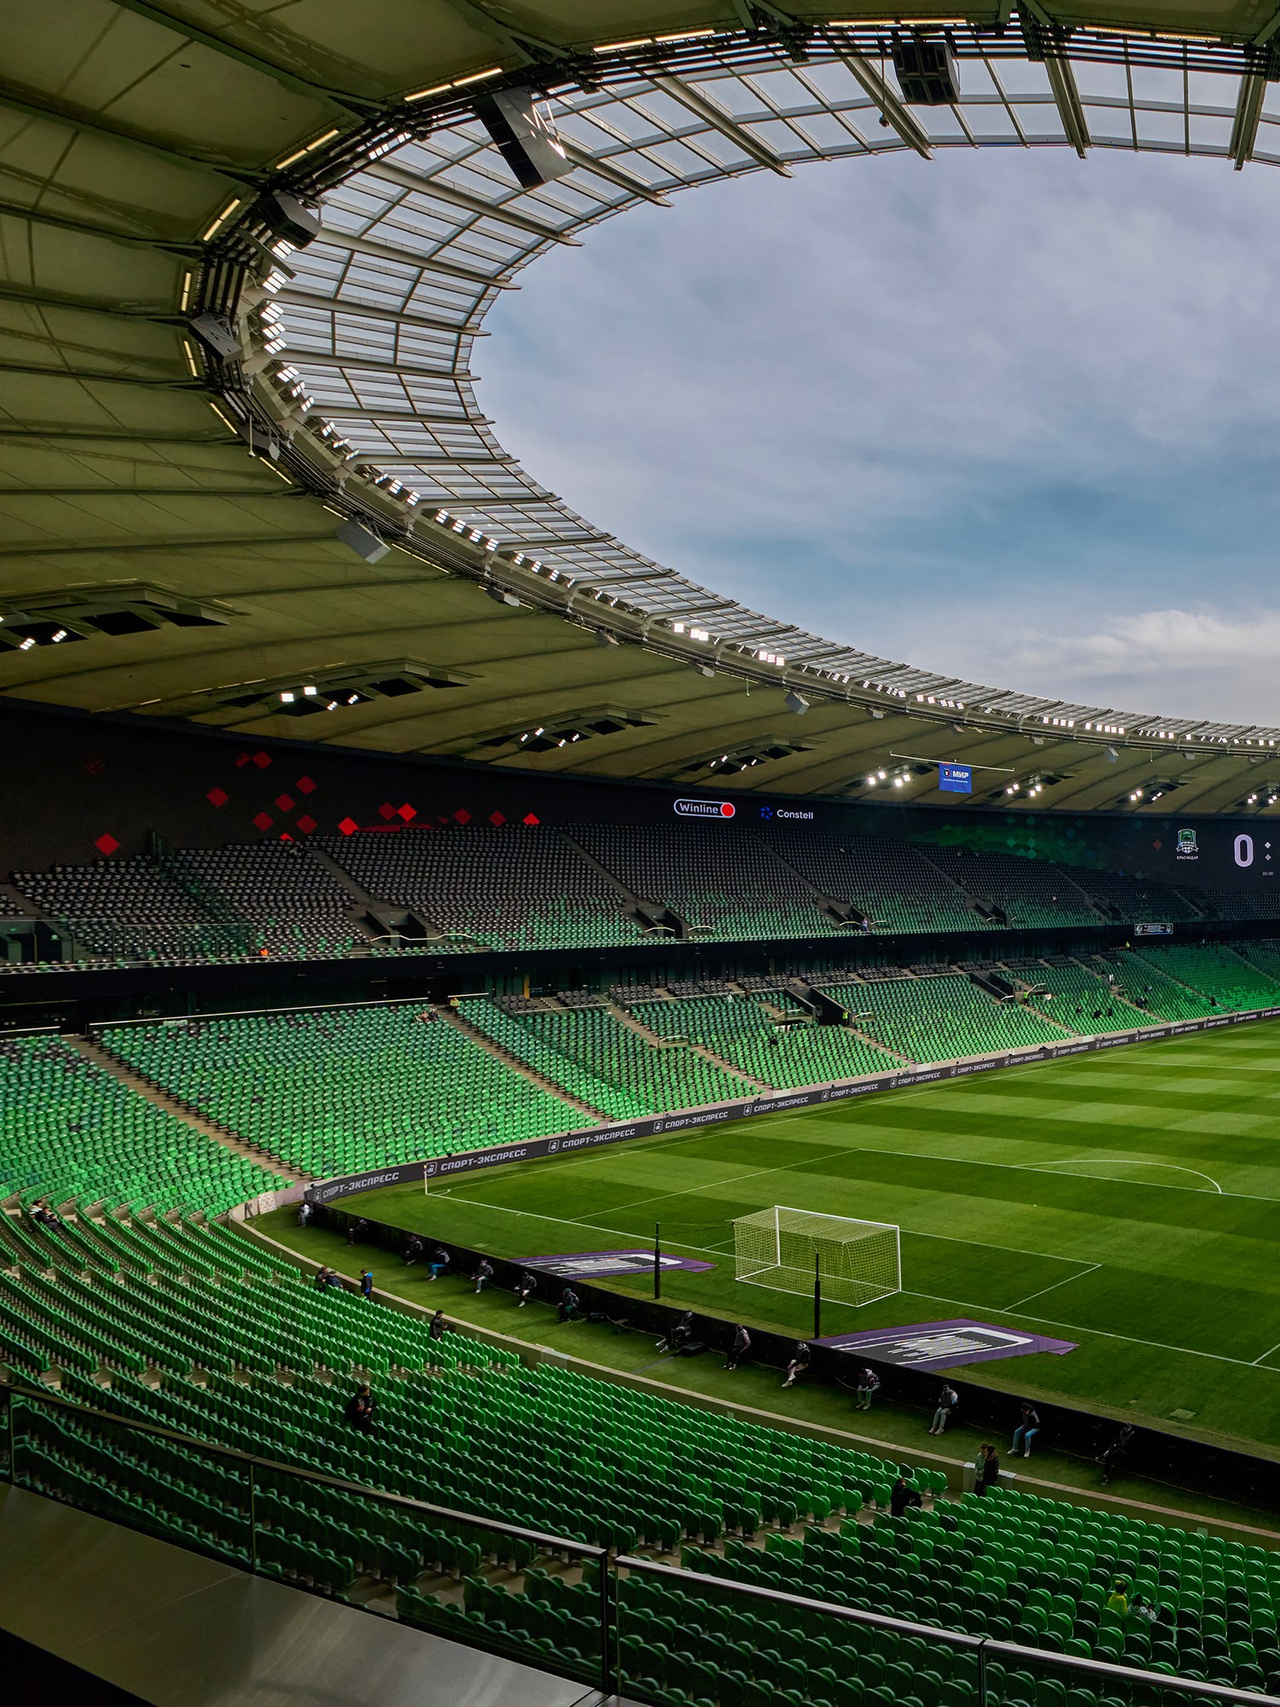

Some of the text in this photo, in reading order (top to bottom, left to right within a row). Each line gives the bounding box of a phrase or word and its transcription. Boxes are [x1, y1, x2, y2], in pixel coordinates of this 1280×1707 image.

[952, 770, 969, 779] МИР
[679, 802, 719, 814] Winline
[777, 809, 814, 820] Constell
[1233, 834, 1254, 868] 0
[958, 1062, 995, 1074] СПОРТ-ЭКСПРЕСС
[898, 1072, 940, 1085] СПОРТ-ЭКСПРЕСС
[831, 1084, 879, 1098] СПОРТ-ЭКСПРЕСС
[754, 1096, 809, 1113] СПОРТ-ЭКСПРЕСС
[665, 1111, 728, 1129] СПОРТ-ЭКСПРЕСС
[562, 1128, 636, 1149] СПОРТ-ЭКСПРЕСС
[441, 1148, 527, 1171] СПОРТ-ЭКСПРЕСС
[323, 1172, 399, 1199] СПОРТ-ЭКСПРЕСС
